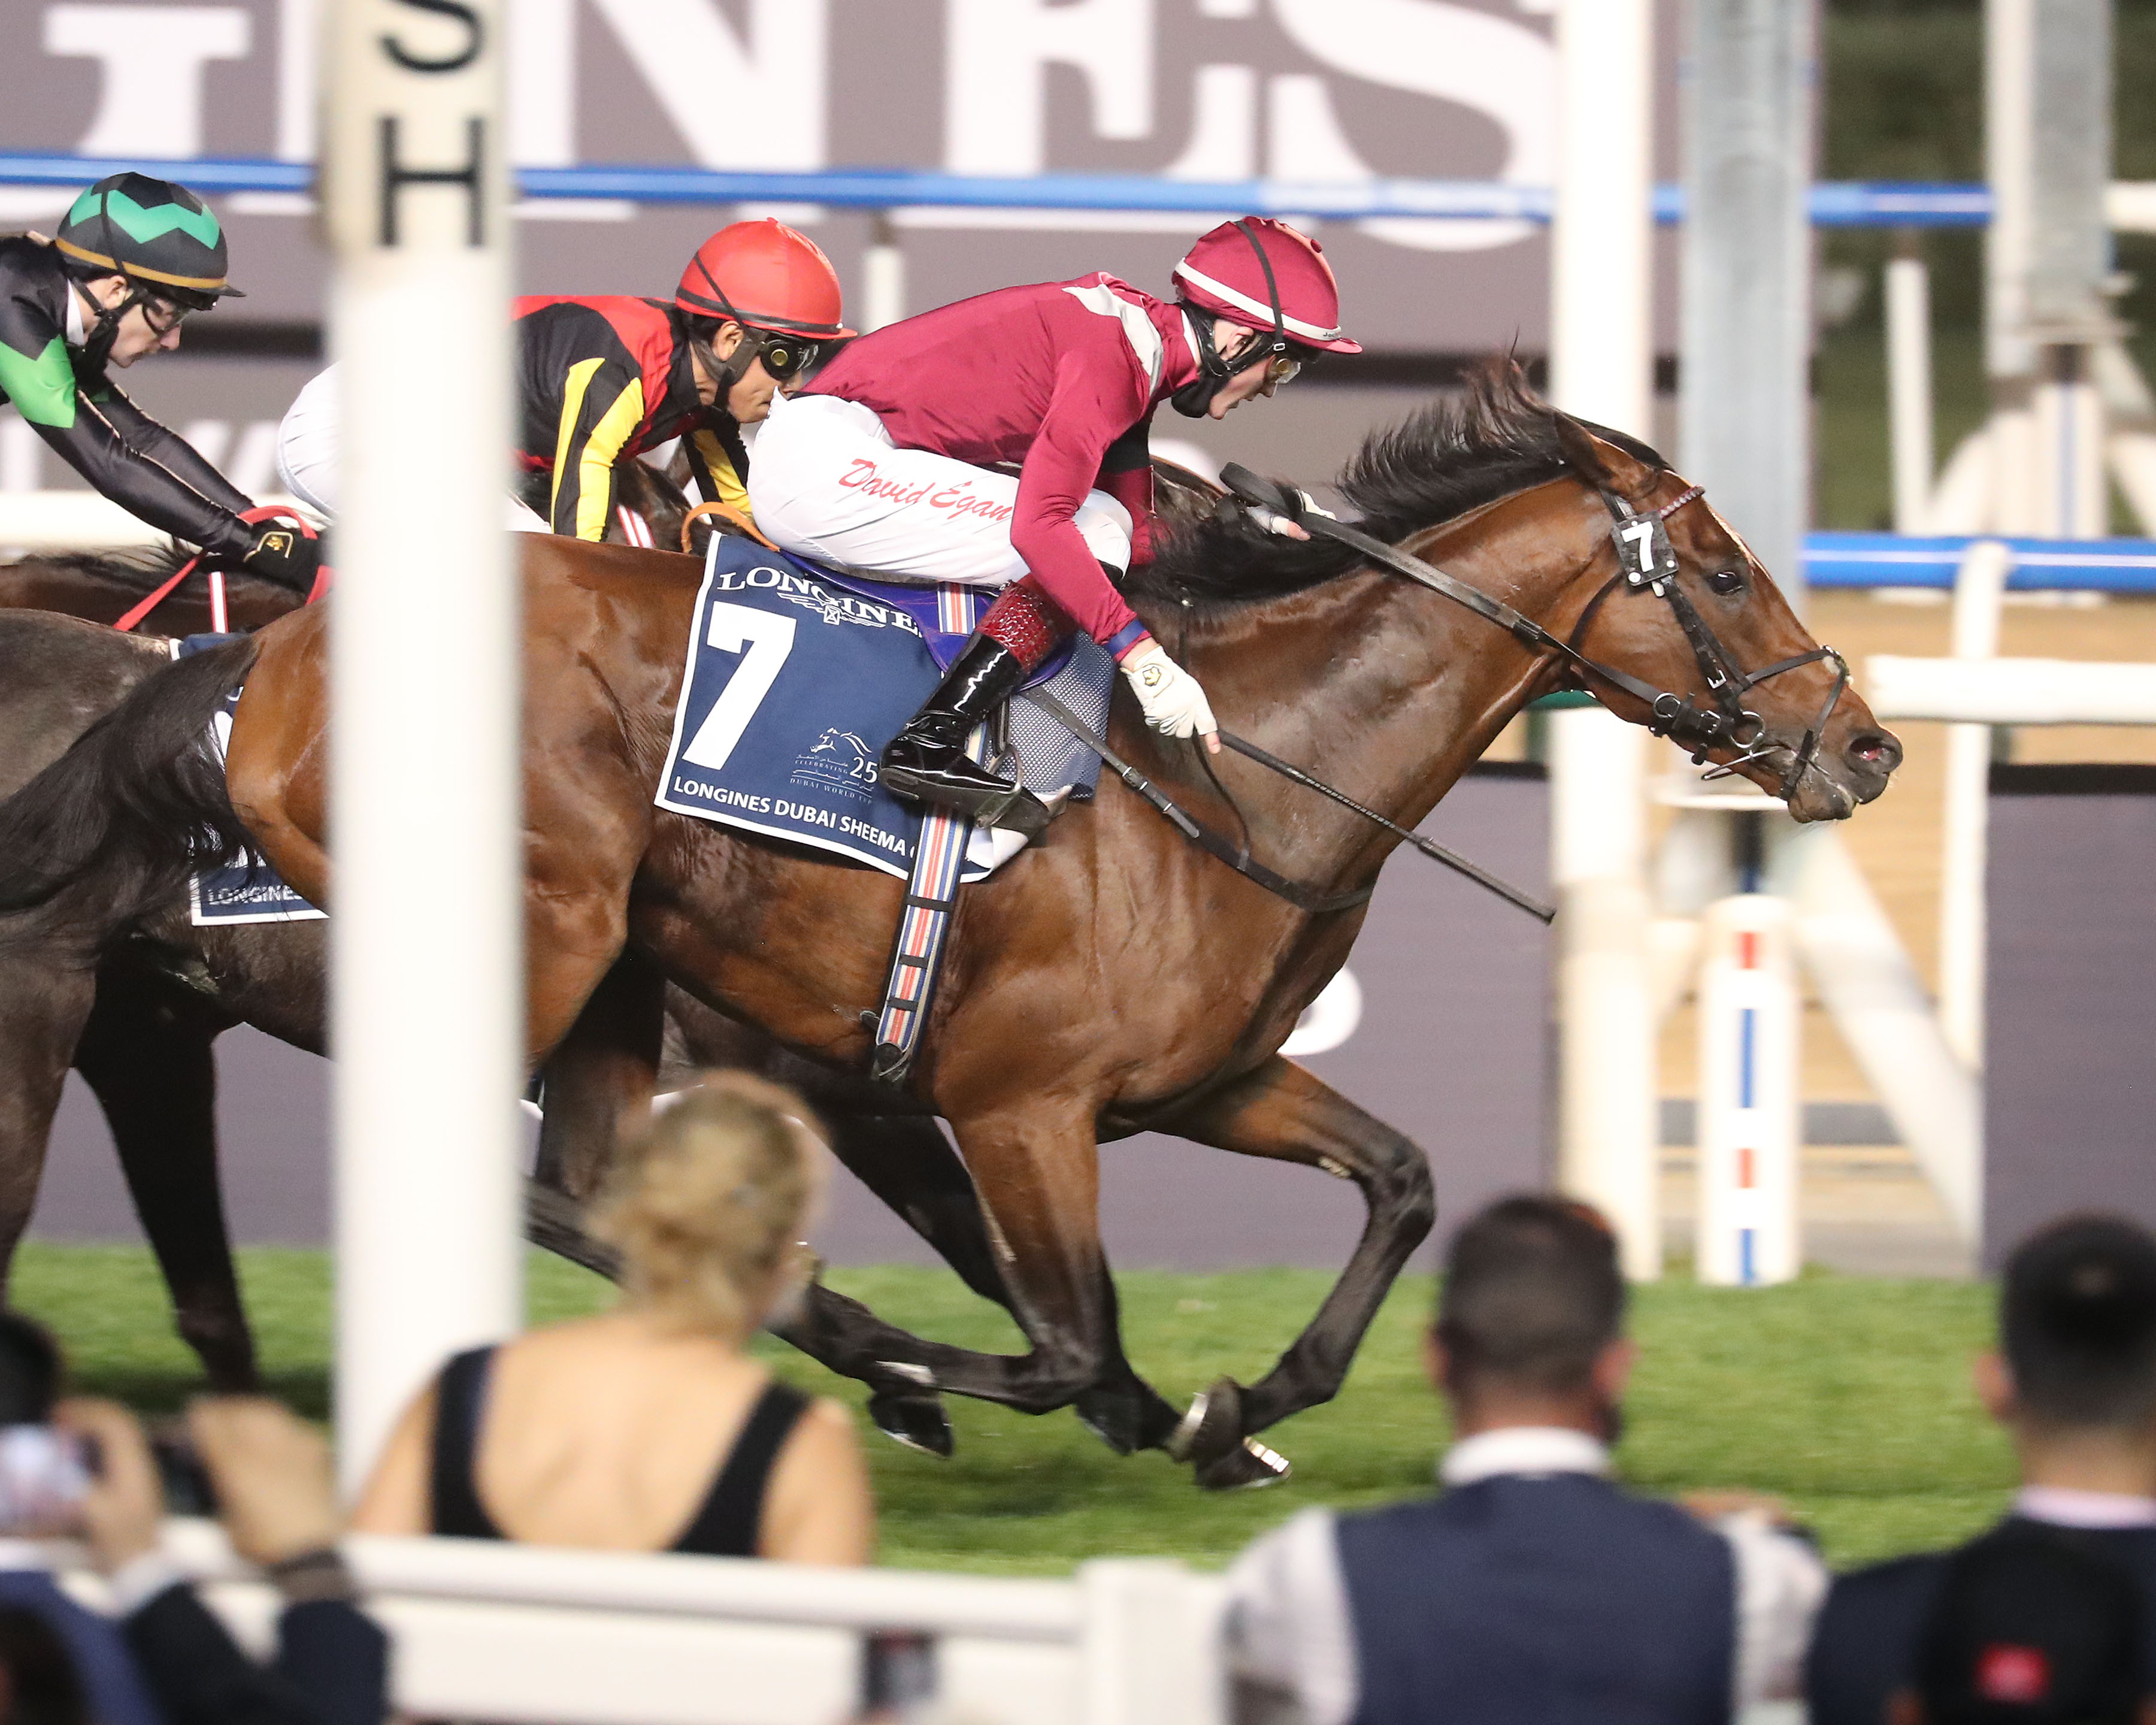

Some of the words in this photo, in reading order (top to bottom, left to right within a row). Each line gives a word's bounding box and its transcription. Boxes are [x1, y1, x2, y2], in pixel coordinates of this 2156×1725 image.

[838, 459, 935, 504] David
[1621, 521, 1654, 572] 7
[717, 566, 923, 638] LONGINE
[682, 601, 797, 771] 7
[790, 777, 819, 789] DUBAI
[823, 785, 855, 798] WORLD
[795, 759, 848, 774] CELEBRATING
[849, 756, 878, 783] 25
[673, 776, 771, 814] LONGINES
[774, 799, 836, 829] DUBAI
[839, 815, 906, 857] SHEEMA
